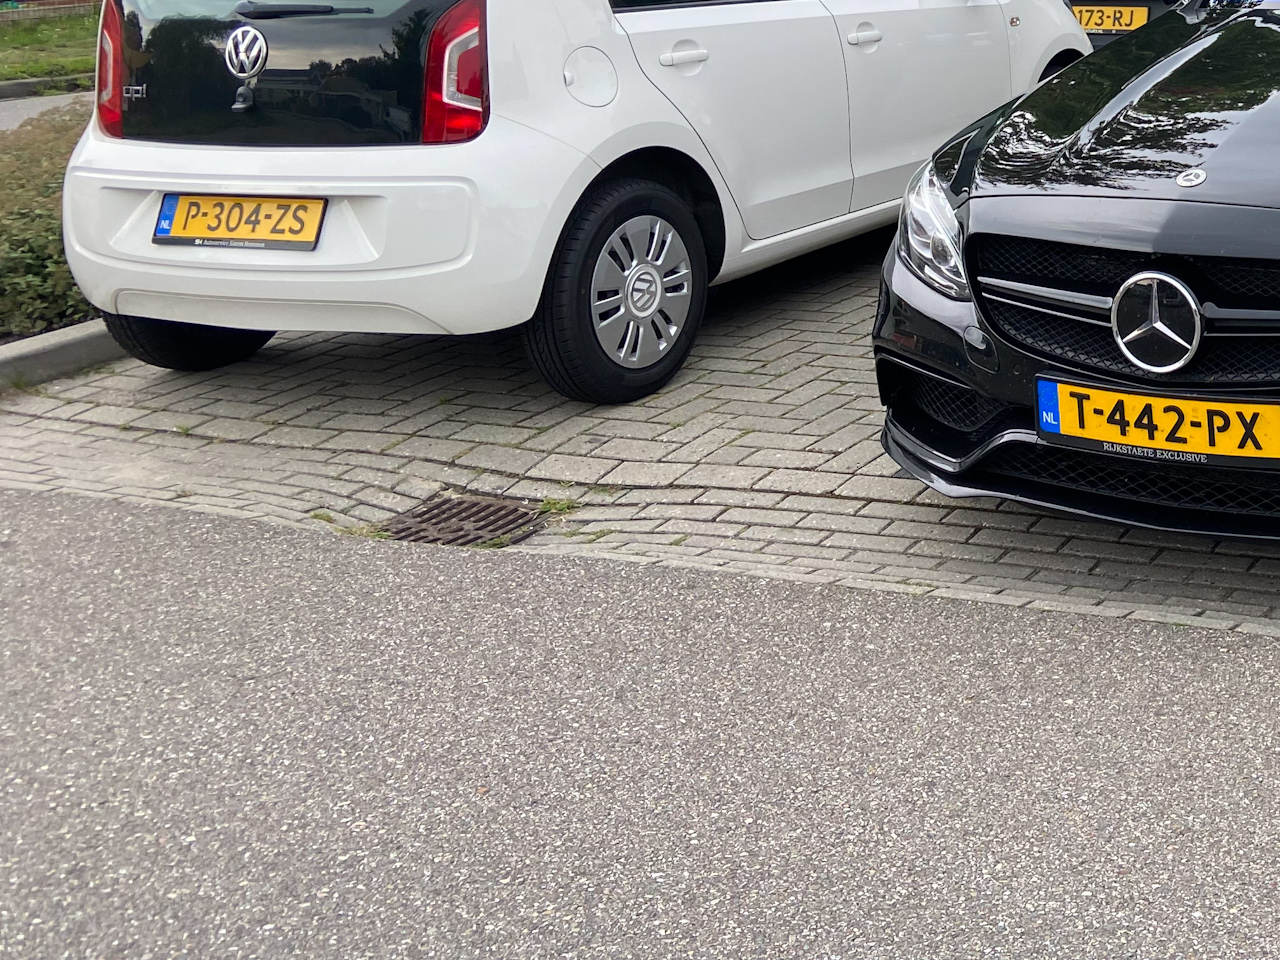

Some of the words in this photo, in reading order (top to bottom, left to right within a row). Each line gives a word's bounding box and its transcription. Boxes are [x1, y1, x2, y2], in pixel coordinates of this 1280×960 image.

[160, 220, 171, 229] NL
[182, 201, 308, 235] P-304-ZS
[1042, 411, 1058, 425] NL
[1069, 391, 1263, 451] T-442-PX
[1102, 442, 1155, 457] RIJKSTAETE
[1156, 449, 1208, 463] EXCLUSIVE
